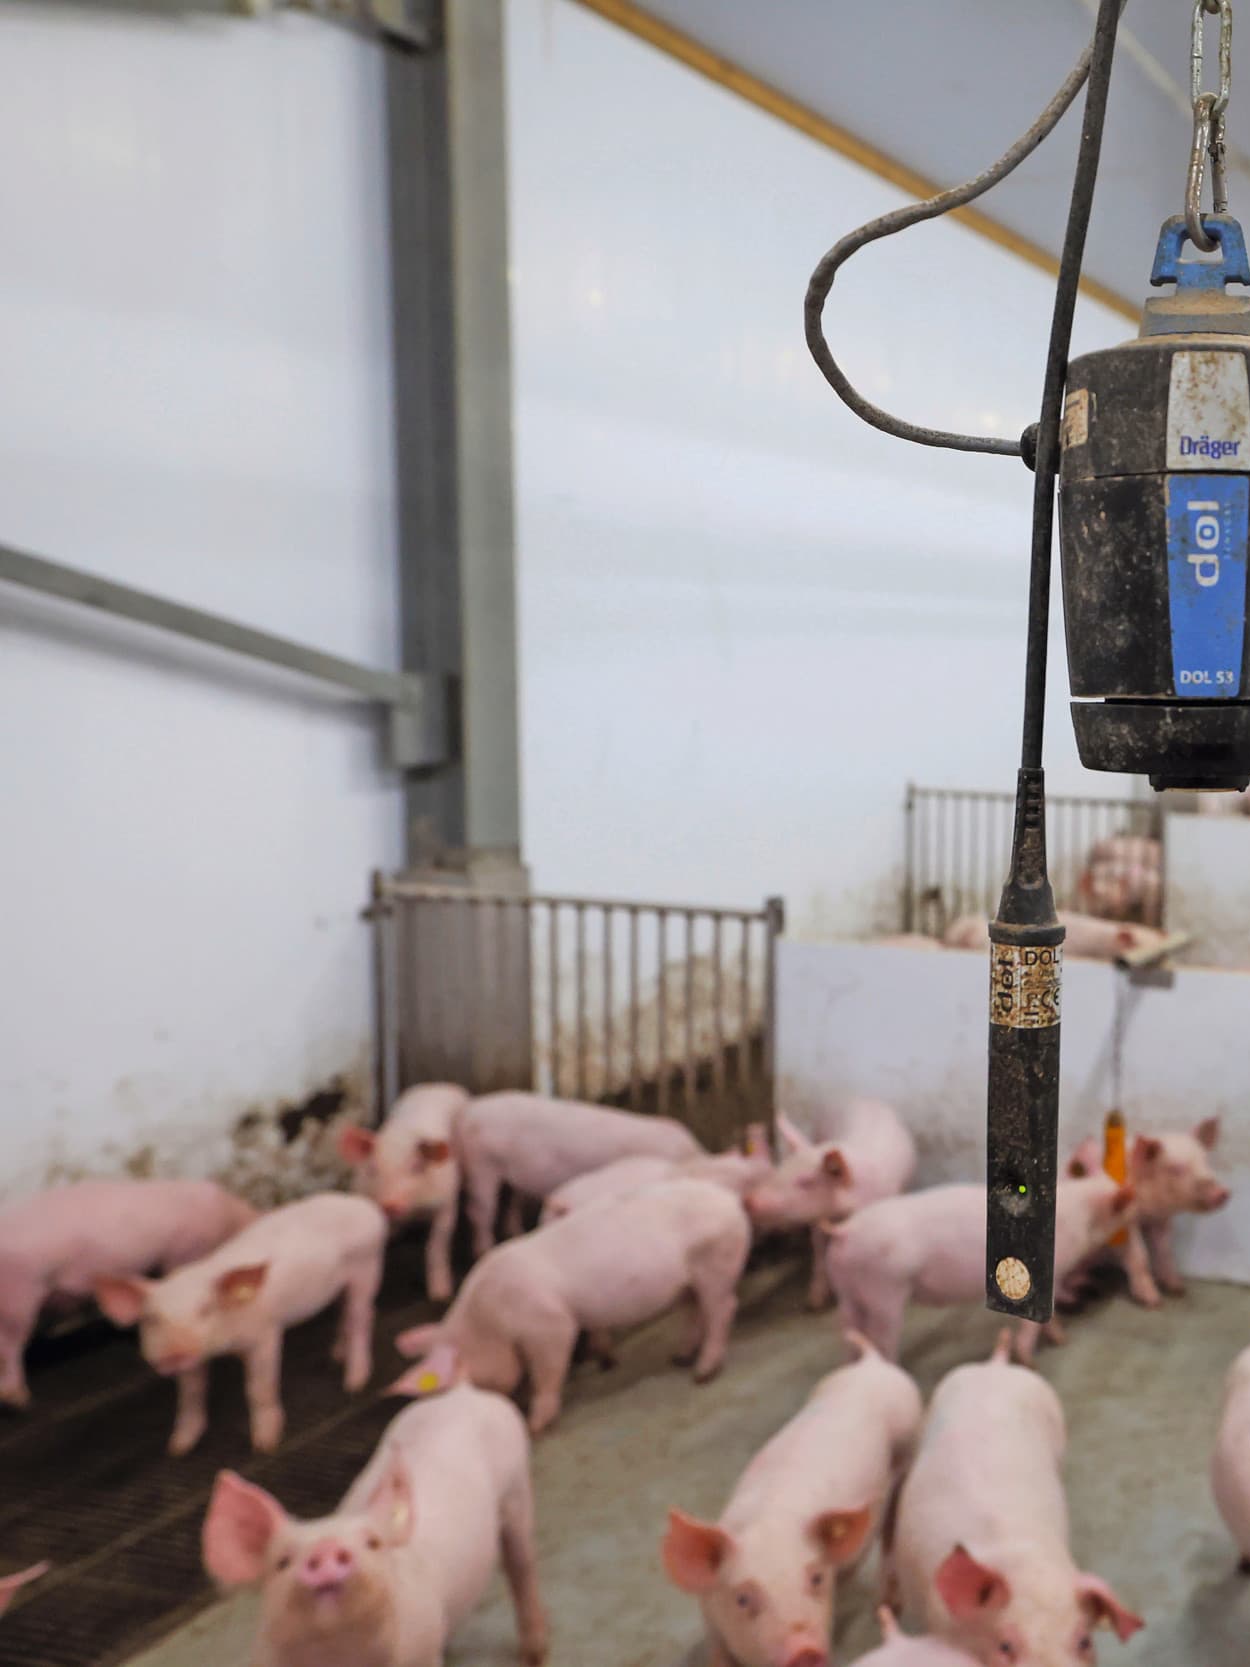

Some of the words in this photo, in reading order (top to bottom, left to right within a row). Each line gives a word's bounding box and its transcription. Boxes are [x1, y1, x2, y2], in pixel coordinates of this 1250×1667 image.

[1179, 435, 1241, 459] Dräger
[1187, 500, 1220, 587] dol
[1180, 670, 1212, 684] DOL
[1215, 670, 1234, 684] 53
[1025, 948, 1059, 966] DOL
[997, 958, 1014, 1013] dol
